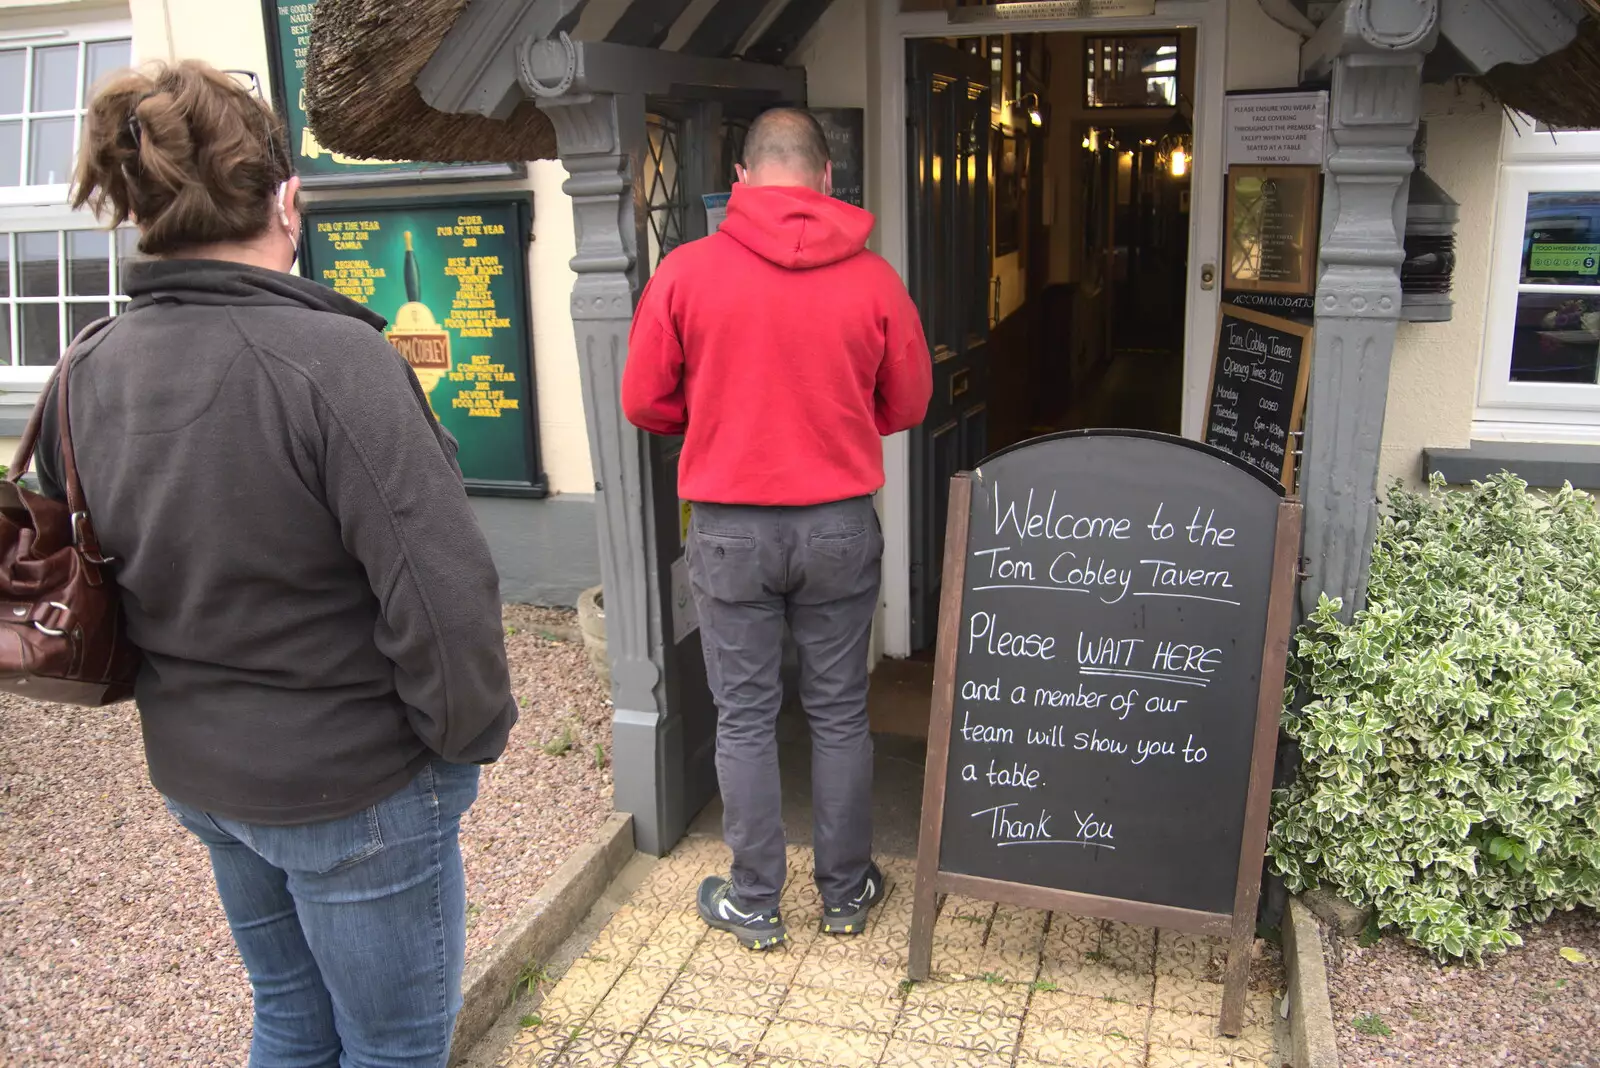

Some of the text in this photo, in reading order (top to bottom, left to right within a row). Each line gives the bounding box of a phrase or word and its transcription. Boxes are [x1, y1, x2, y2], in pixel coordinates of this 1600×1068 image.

[278, 7, 288, 15] THE
[290, 4, 307, 13] GOOD
[291, 25, 308, 35] BEST
[458, 216, 483, 225] CIDER
[318, 221, 380, 232] PUB OF THE YEAR
[437, 225, 505, 236] PUB OF THE YEAR
[335, 260, 371, 269] REGIONAL
[448, 256, 499, 266] BEST DEVON
[1587, 259, 1592, 267] 5
[323, 268, 386, 278] PUB OF THE YEAR
[444, 265, 503, 276] SUNDAY ROAST
[458, 275, 491, 284] WINNER
[364, 286, 375, 295] UP
[456, 291, 492, 300] FINALIST
[451, 310, 496, 319] DEVON LIFE
[444, 318, 511, 328] FOOD AND DRINK
[460, 328, 493, 337] AWARDS
[1226, 323, 1292, 364] Tom Cobley Tavern
[412, 337, 445, 363] COBLEY
[472, 355, 491, 364] BEST
[457, 363, 505, 372] COMMUNITY
[1224, 357, 1284, 384] Opening Times 2021
[449, 372, 515, 381] PUB OF THE YEAR
[459, 390, 505, 399] DEVON LIFE
[1216, 385, 1278, 411] Monday CLOSED
[452, 399, 519, 409] FOOD AND DRINK
[469, 408, 501, 417] AWARDS
[1213, 404, 1238, 426] Tuesday
[1254, 416, 1265, 432] 6pm
[995, 481, 1236, 547] Welcome to the
[974, 547, 1233, 604] Tom Cobley Tavern
[968, 612, 1222, 673] Please WAIT HERE
[961, 677, 1188, 720] and a member of our
[960, 711, 1207, 764] team will show you to
[961, 762, 1046, 787] a table.
[971, 803, 1114, 840] Thank You
